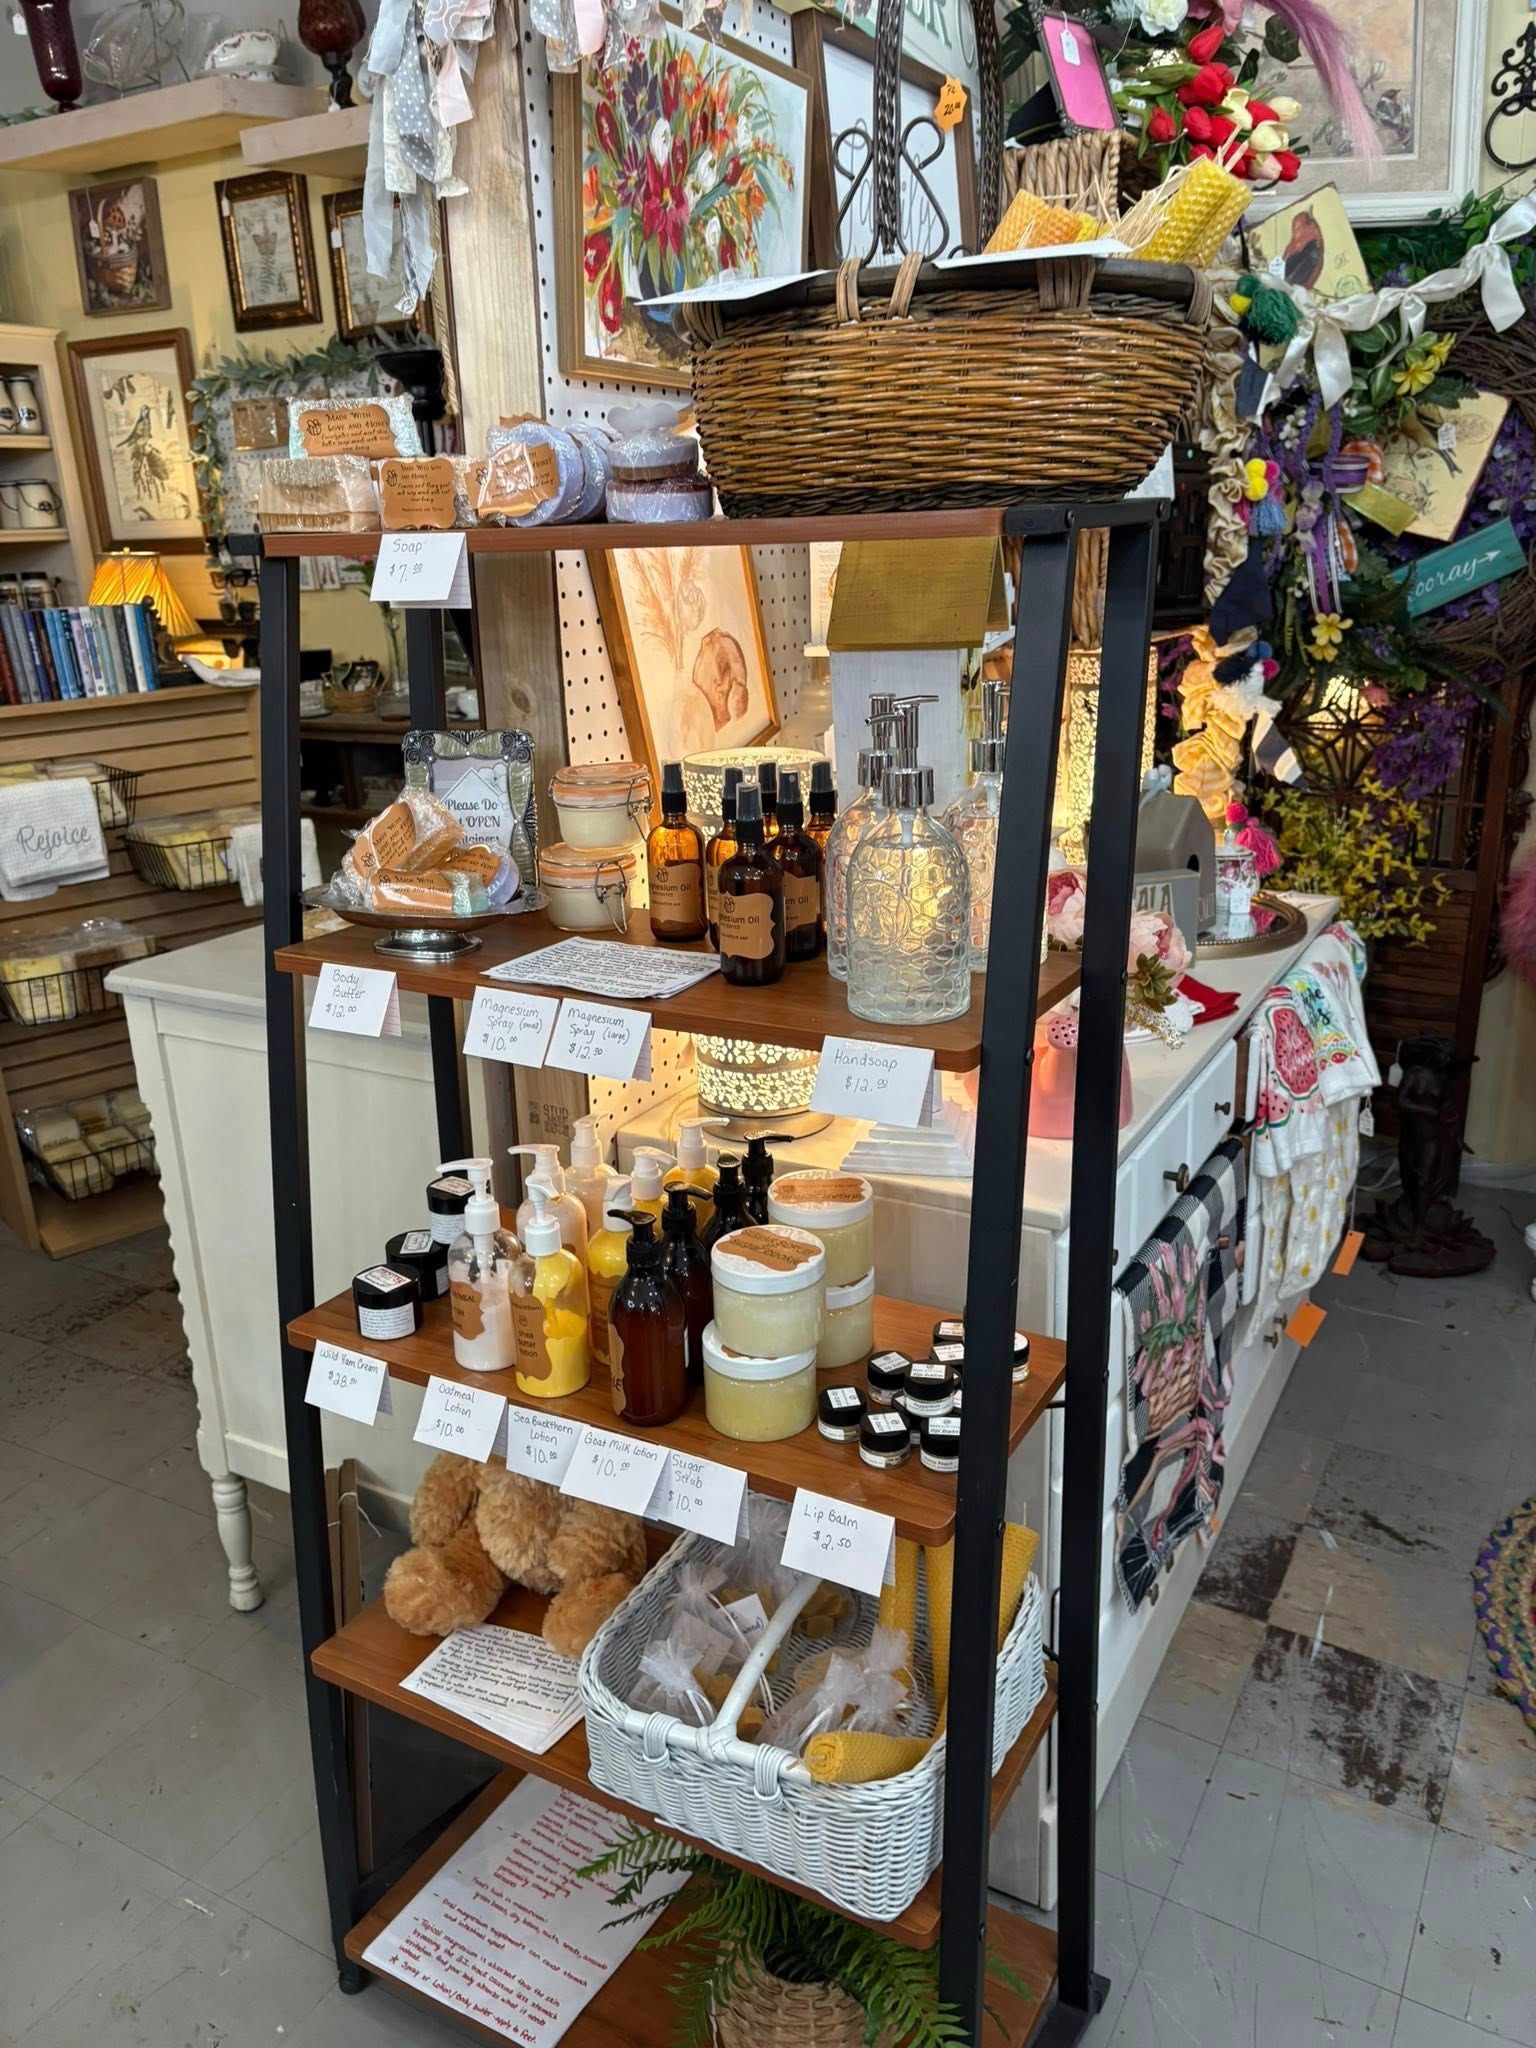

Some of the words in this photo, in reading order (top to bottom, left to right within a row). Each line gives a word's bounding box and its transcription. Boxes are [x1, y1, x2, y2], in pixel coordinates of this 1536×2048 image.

[393, 538, 423, 553] Soap
[1407, 557, 1478, 602] ooray
[445, 799, 480, 811] Please
[481, 798, 498, 811] Do
[465, 815, 500, 828] OPEN
[17, 825, 91, 859] Rejoice
[680, 883, 691, 892] Oil
[798, 896, 809, 904] Oil
[748, 915, 760, 924] Oil
[333, 969, 359, 989] Body
[333, 985, 366, 999] Butter
[325, 1003, 358, 1018] $12.00
[480, 997, 539, 1018] Magnesium
[487, 1015, 514, 1033] Spray
[568, 1007, 625, 1028] Magnesium
[482, 1033, 518, 1051] $10.00
[569, 1024, 596, 1043] Spray
[834, 1048, 898, 1072] Handsoap
[845, 1075, 889, 1093] $12.00
[543, 1103, 569, 1117] STUD
[319, 1349, 339, 1361] Wild
[341, 1351, 357, 1369] Yam
[357, 1360, 379, 1375] Cream
[438, 1383, 475, 1403] Oatmeal
[444, 1399, 472, 1418] Lotion
[435, 1418, 465, 1437] $10.00
[513, 1411, 530, 1425] Sea
[532, 1415, 574, 1435] Buckthorn
[530, 1429, 558, 1446] Lotion
[584, 1431, 607, 1447] Goat
[609, 1438, 630, 1454] Milk
[633, 1445, 658, 1461] Lotion
[592, 1454, 631, 1477] $10.00
[672, 1454, 705, 1476] Sugar
[674, 1470, 703, 1489] Scrub
[668, 1490, 704, 1513] $10.00
[804, 1503, 824, 1523] Lip
[828, 1509, 858, 1530] Balm
[812, 1530, 852, 1550] $2.50
